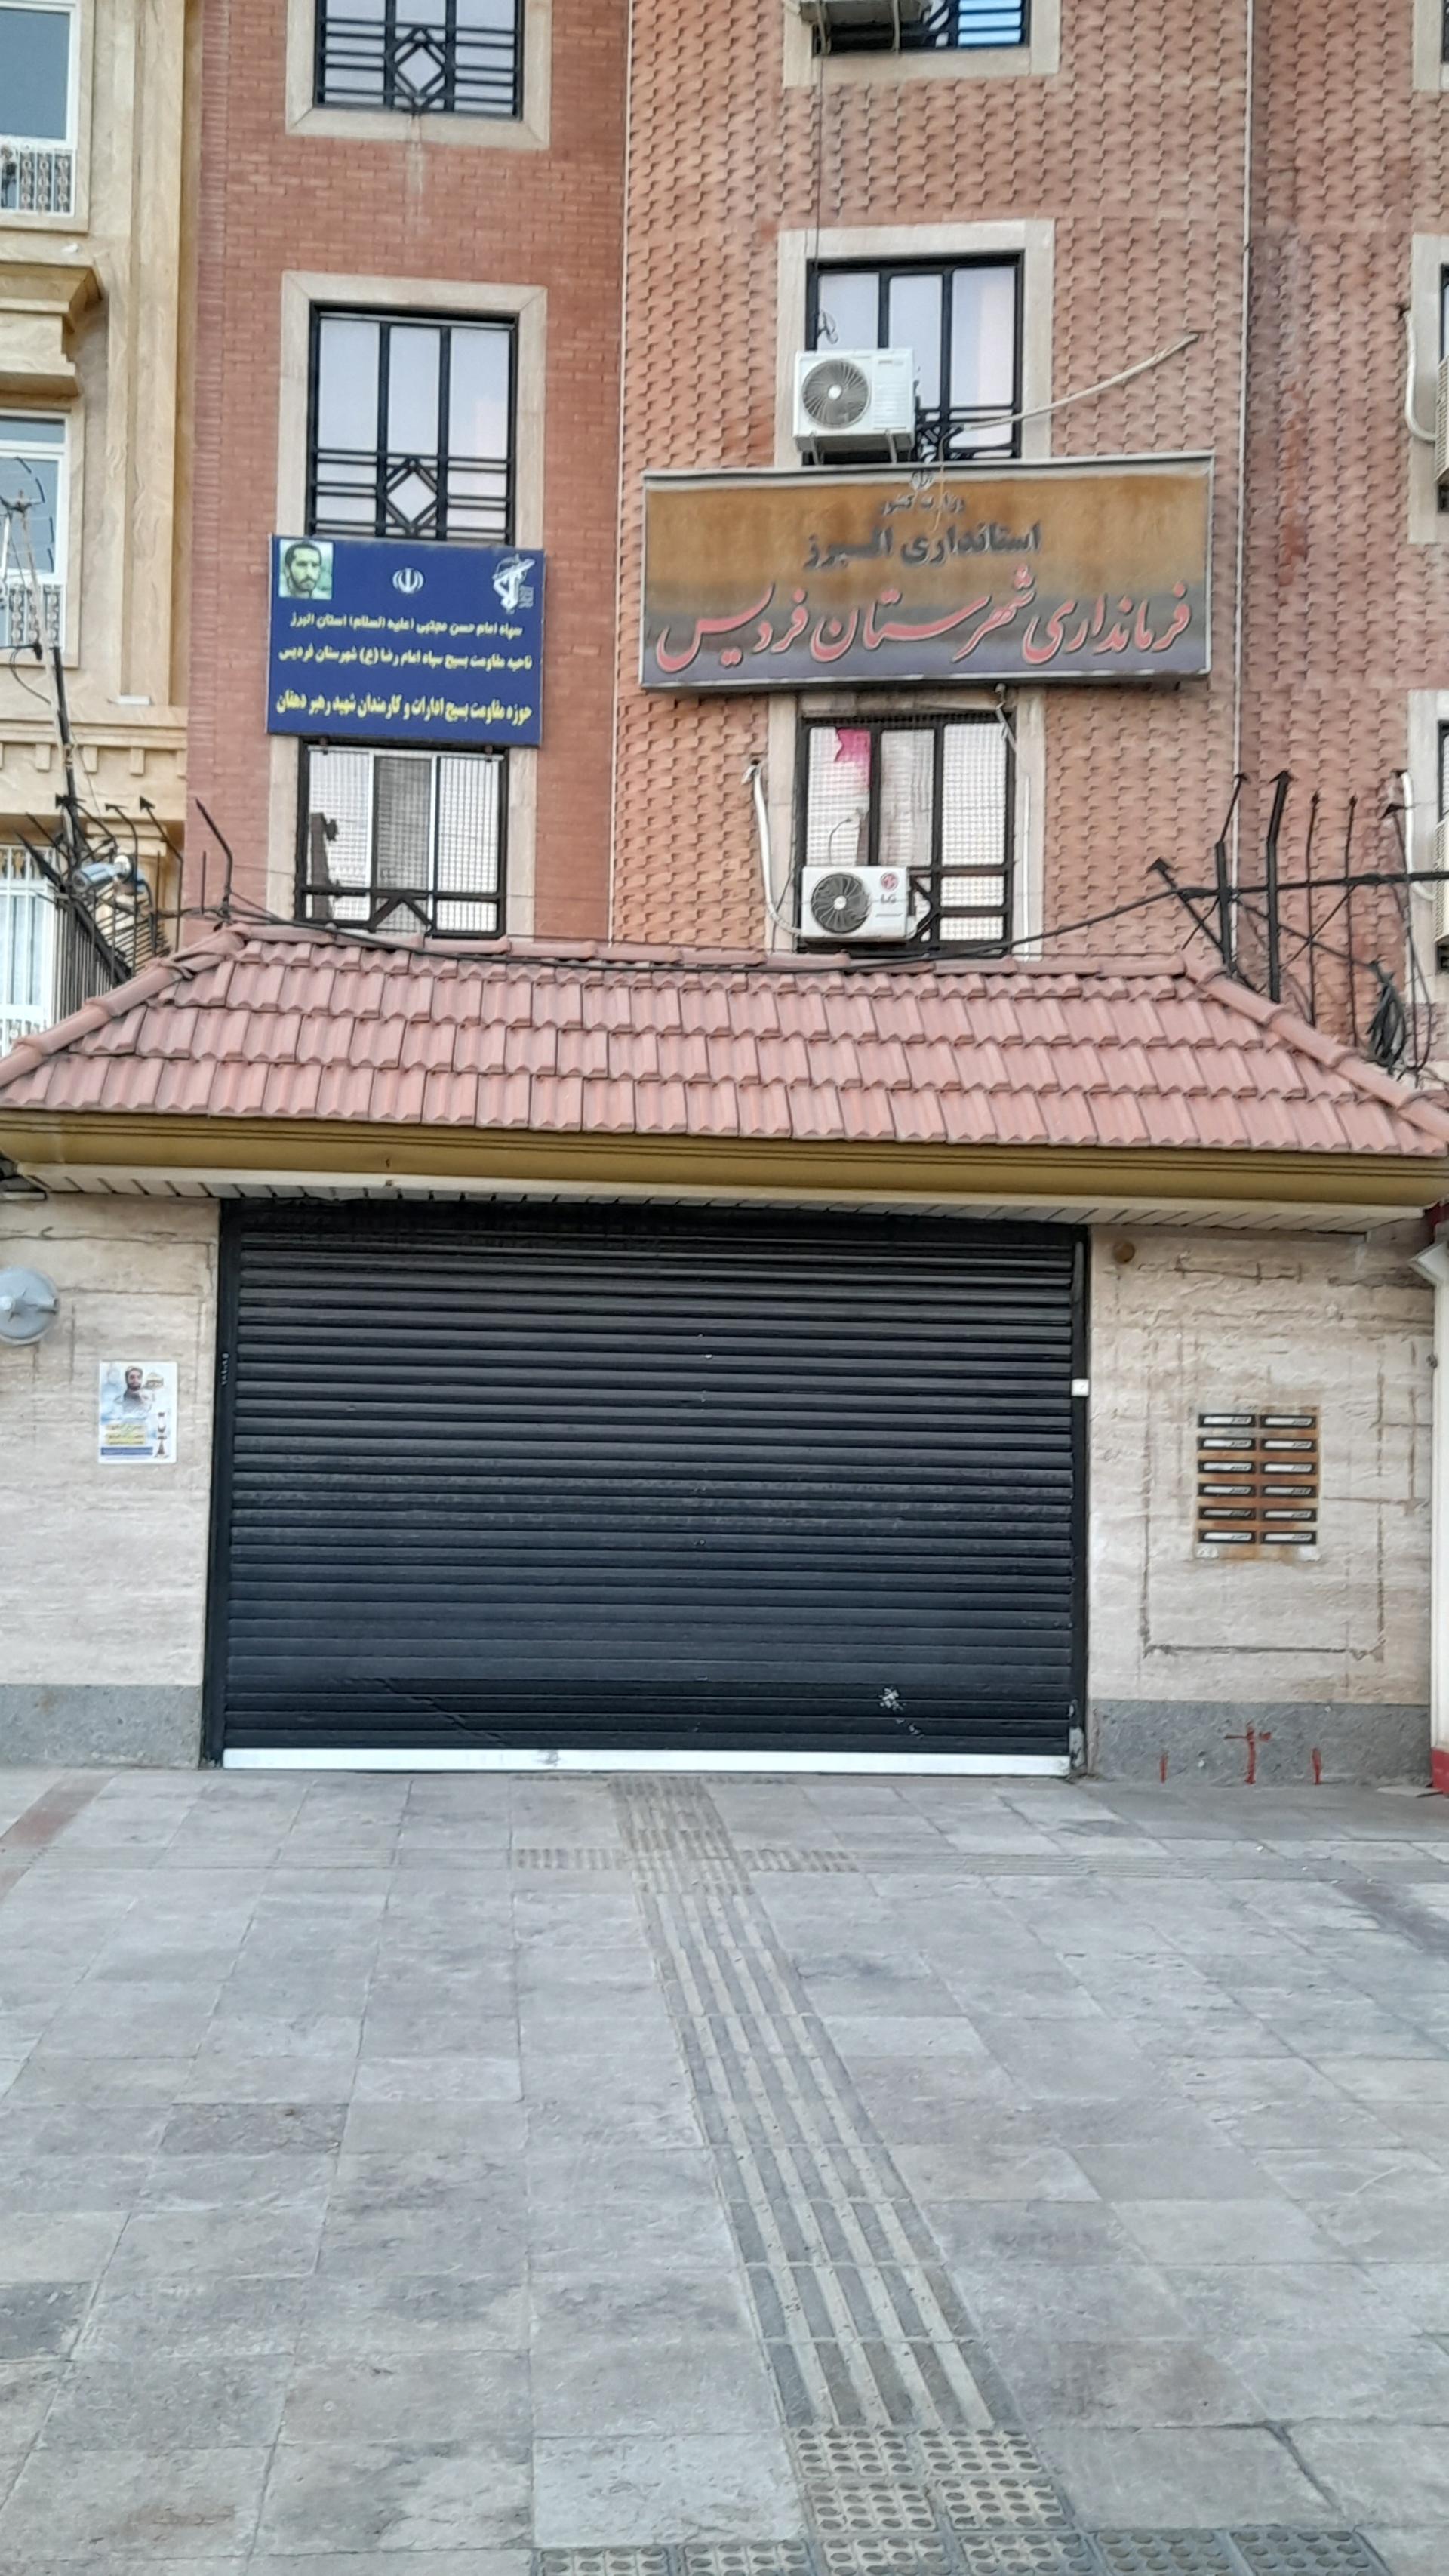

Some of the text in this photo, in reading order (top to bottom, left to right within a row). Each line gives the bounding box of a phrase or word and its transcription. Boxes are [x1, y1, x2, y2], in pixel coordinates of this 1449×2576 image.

[921, 491, 967, 514] وزات
[803, 521, 1041, 568] استانداری البرز
[290, 611, 315, 628] البرز
[317, 614, 347, 630] استان
[656, 562, 1192, 673] فرمانداری شهرستان فردیس
[449, 623, 475, 636] حسن
[476, 622, 498, 638] امام
[499, 623, 523, 640] سپاه
[278, 642, 314, 662] فردیس
[315, 645, 358, 664] شهرستان
[359, 647, 379, 666] (ع)
[380, 648, 399, 666] رضا
[400, 649, 421, 667] امام
[422, 650, 444, 669] سپاه
[445, 654, 469, 669] بسیج
[470, 653, 505, 672] مقاومت
[276, 688, 307, 714] دهقان
[333, 692, 356, 716] شهید
[357, 692, 402, 720] کارمندان
[411, 695, 445, 722] ادارات
[403, 702, 411, 720] و
[445, 702, 469, 722] بسیج
[470, 699, 505, 725] مقاومت
[506, 703, 532, 726] حوزه
[880, 893, 897, 904] LG
